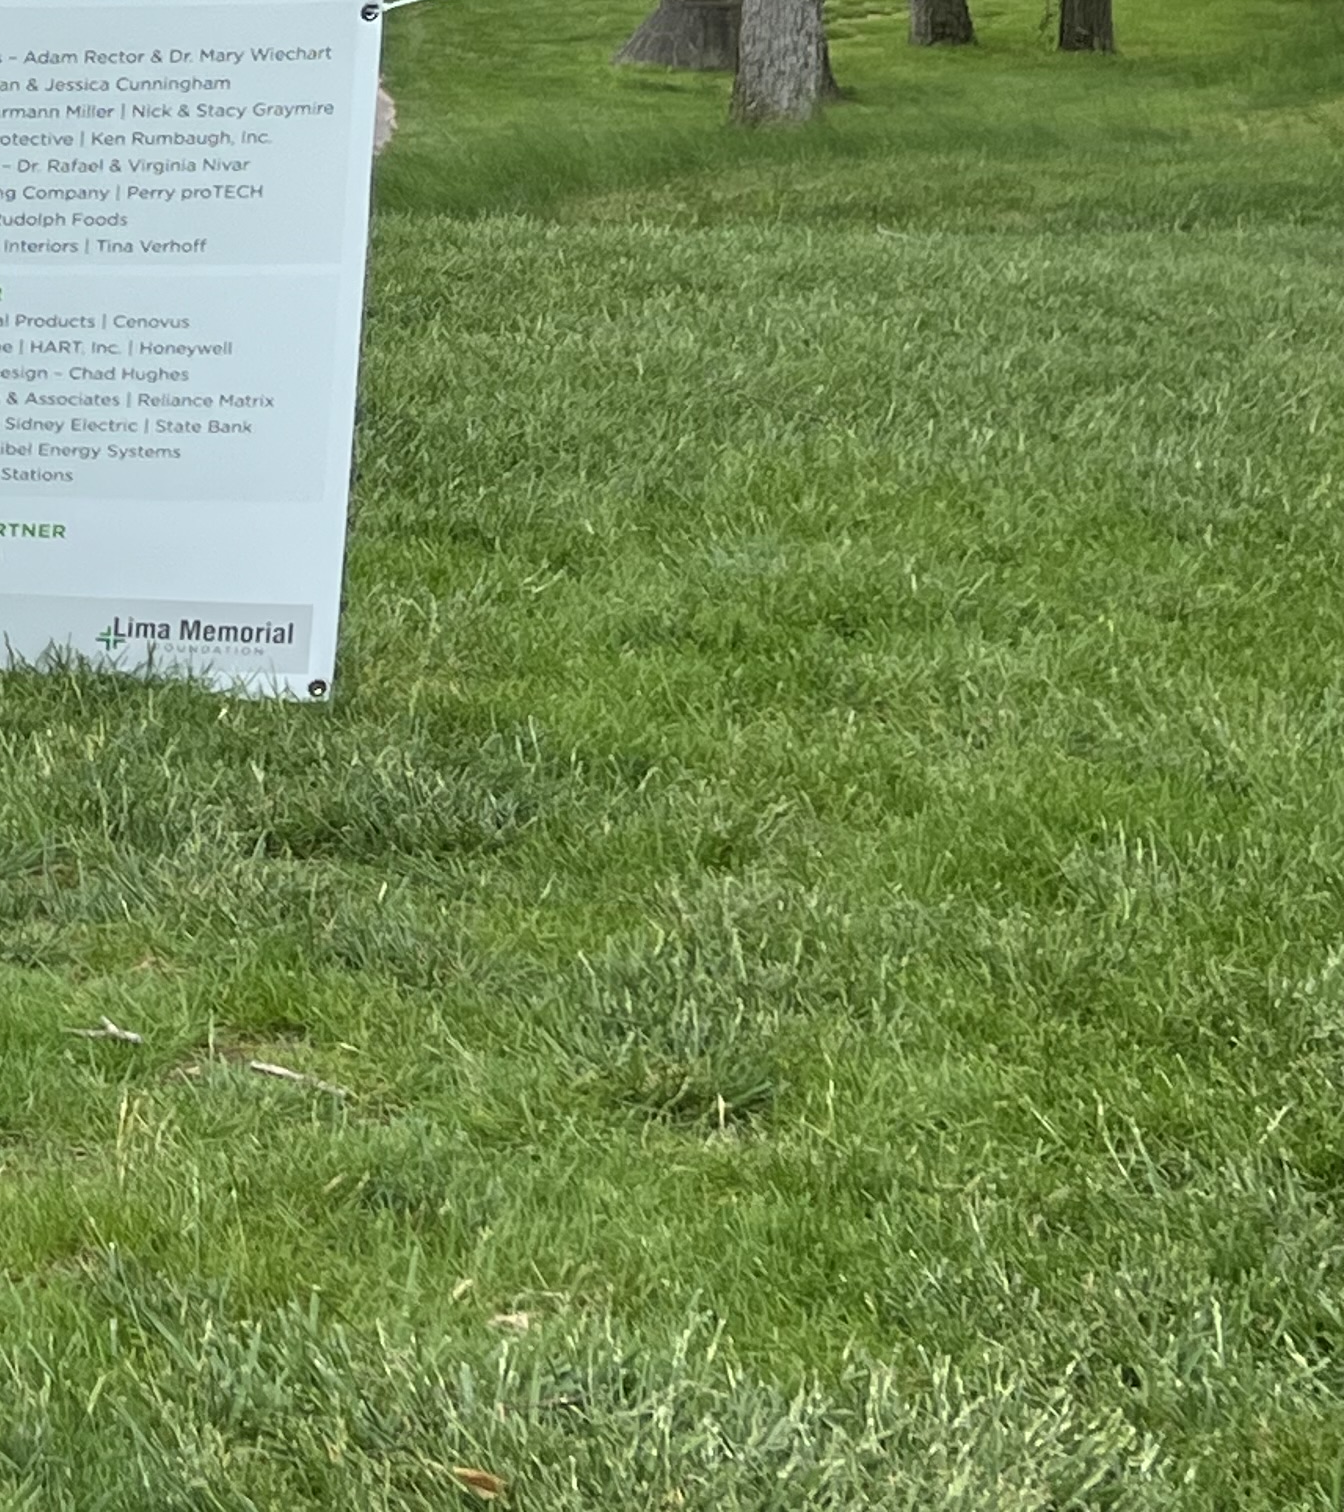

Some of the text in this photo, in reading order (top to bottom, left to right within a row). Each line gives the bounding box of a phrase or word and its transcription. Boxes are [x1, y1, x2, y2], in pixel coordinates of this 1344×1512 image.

[22, 49, 78, 65] Adam
[83, 49, 146, 65] Rector
[149, 48, 163, 64] &
[199, 48, 245, 66] Mary
[65, 103, 115, 119] Miller
[131, 103, 172, 119] Nick
[176, 103, 190, 118] &
[195, 102, 248, 120] Stacy
[46, 157, 104, 174] Rafael
[108, 157, 122, 173] &
[127, 158, 197, 176] Virginia
[70, 211, 128, 227] Foods
[3, 238, 79, 254] Interiors
[95, 238, 134, 254] Tina
[138, 237, 207, 254] Verhoff
[14, 313, 96, 329] Products
[112, 314, 190, 329] Cenovus
[68, 365, 116, 381] Chad
[120, 366, 190, 384] Hughes
[0, 466, 74, 482] Stations
[113, 616, 294, 645] Lima Memorial
